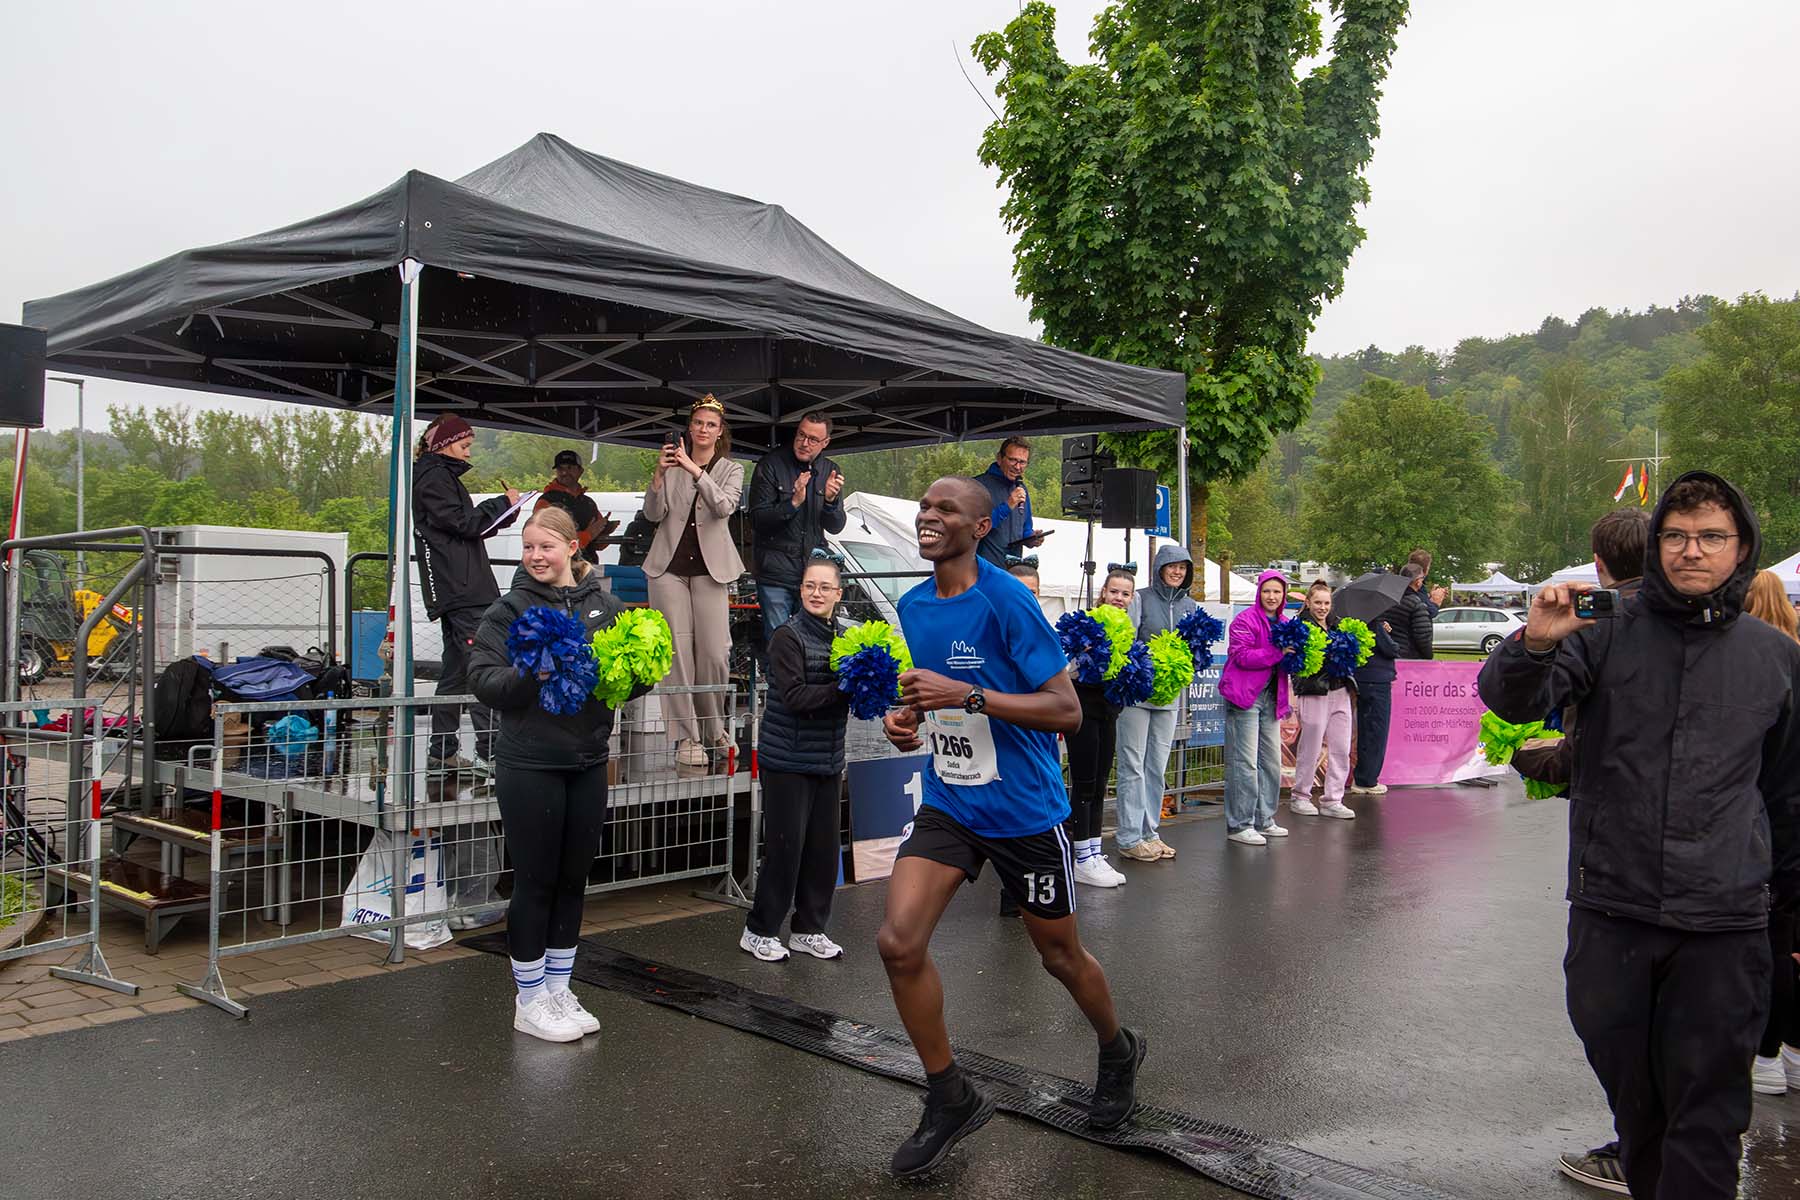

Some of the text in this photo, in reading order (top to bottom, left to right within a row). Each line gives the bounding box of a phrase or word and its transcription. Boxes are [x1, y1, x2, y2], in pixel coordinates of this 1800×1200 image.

[1404, 681, 1439, 698] Feier
[1443, 681, 1466, 698] das
[1420, 706, 1438, 715] 2000
[1404, 719, 1429, 729] Deinen
[930, 732, 973, 759] 1266
[1023, 872, 1056, 905] 13
